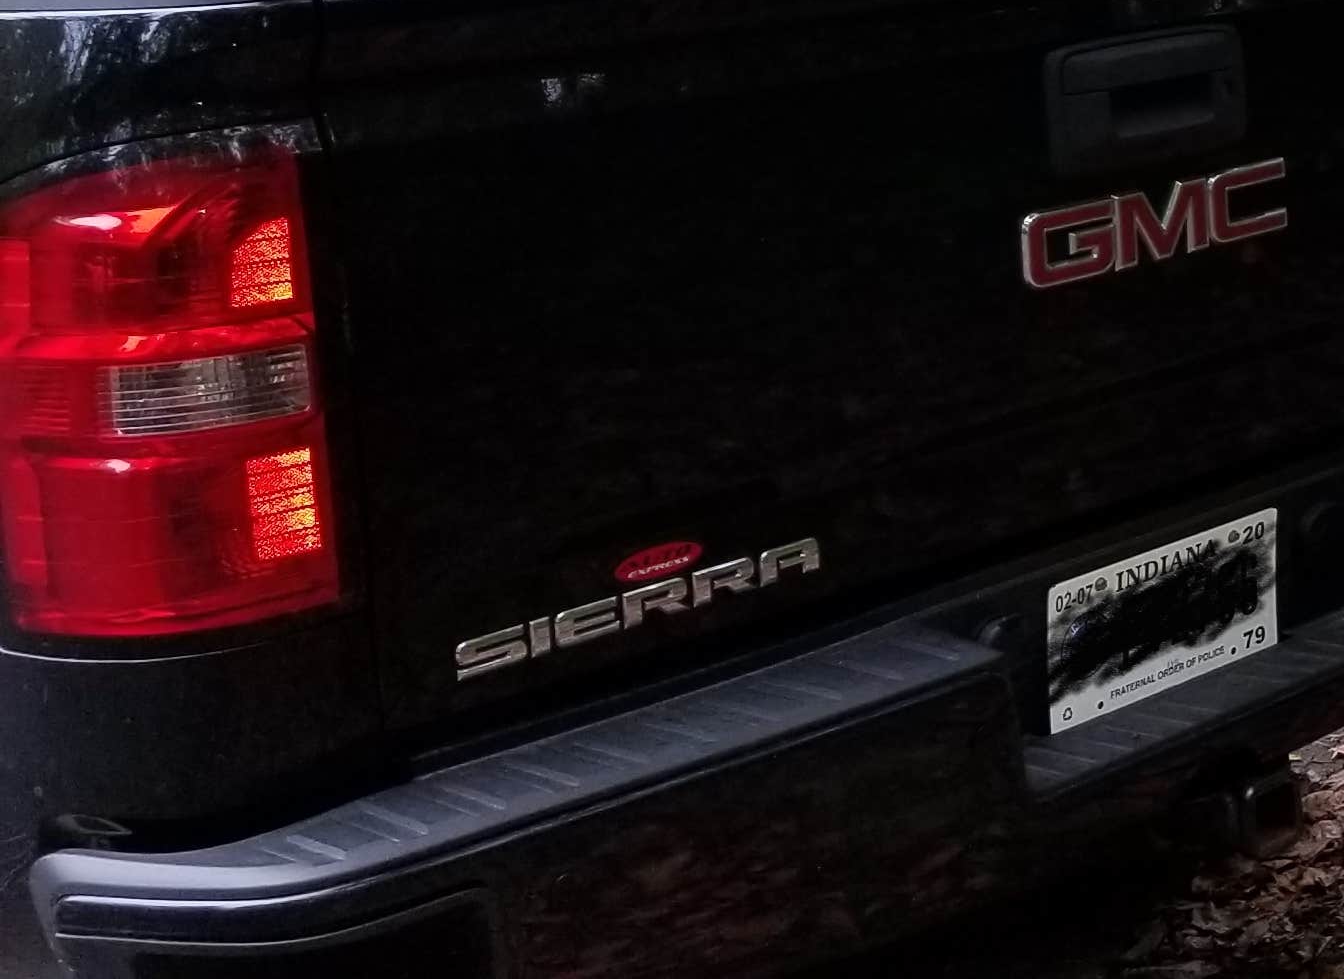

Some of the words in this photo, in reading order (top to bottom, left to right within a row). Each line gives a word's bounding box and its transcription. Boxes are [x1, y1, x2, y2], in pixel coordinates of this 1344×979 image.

[1021, 157, 1289, 288] GMC
[1242, 521, 1265, 545] 20
[455, 537, 821, 682] SIERRA
[1242, 625, 1266, 649] 79
[1110, 674, 1157, 699] FRATERNAL
[1157, 662, 1185, 680] ORDER
[1185, 656, 1198, 669] OF
[1197, 645, 1226, 665] POLICE
